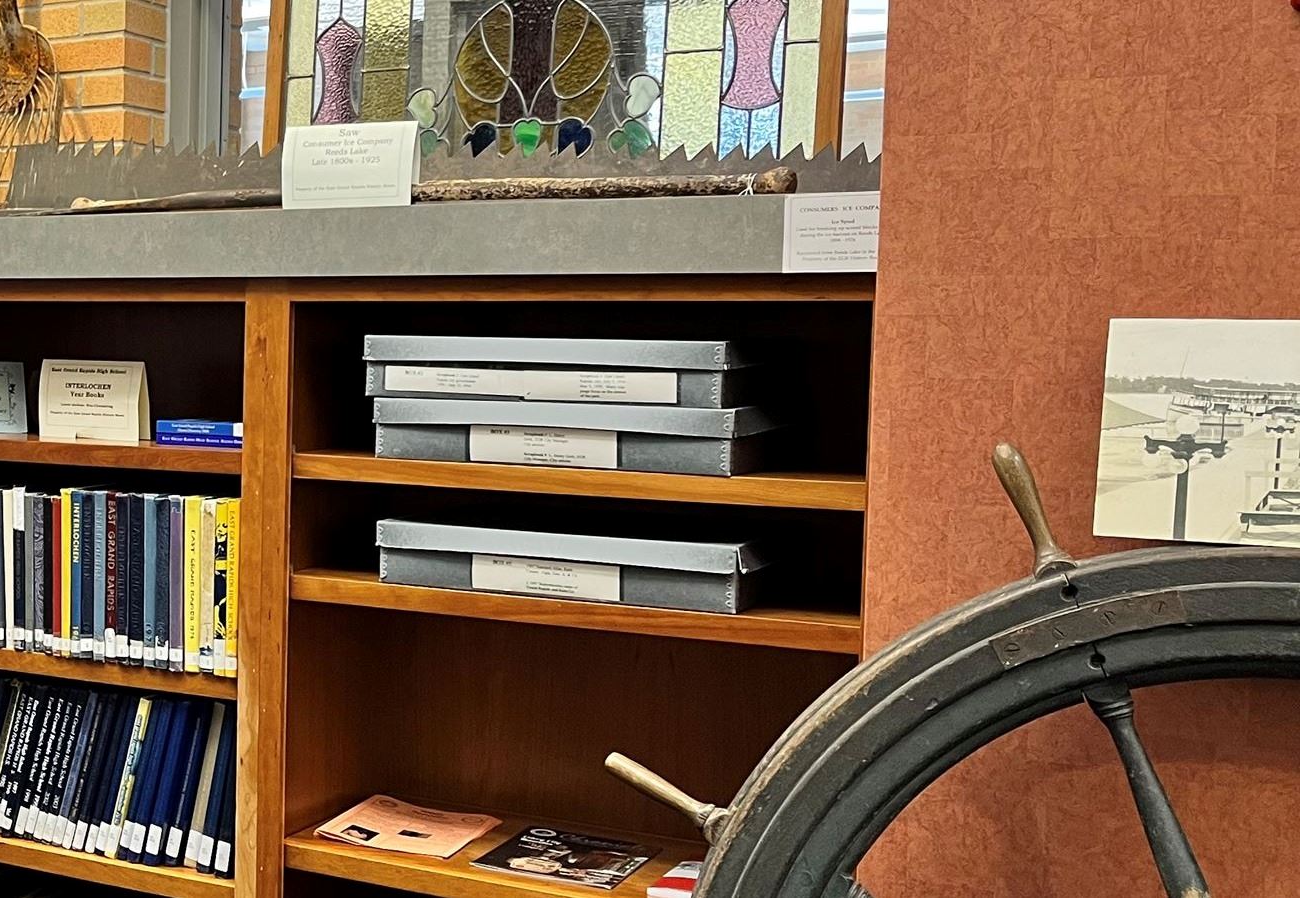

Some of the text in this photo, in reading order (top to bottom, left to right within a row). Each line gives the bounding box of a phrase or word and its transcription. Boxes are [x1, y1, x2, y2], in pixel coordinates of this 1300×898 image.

[339, 129, 359, 137] Saw
[72, 502, 81, 563] INTERLOCHEN
[106, 501, 116, 611] EAST GRAND RAPIDS
[56, 698, 64, 713] East
[65, 701, 73, 715] East
[42, 709, 52, 728] Grand
[51, 712, 60, 734] Grand
[61, 714, 70, 733] Grand
[71, 717, 79, 736] Grand
[37, 728, 47, 747] Rapids
[45, 733, 56, 755] Rapids
[65, 735, 75, 755] Rapids
[33, 747, 42, 762] High
[41, 755, 50, 771] High
[61, 754, 70, 769] High
[57, 768, 67, 788] School
